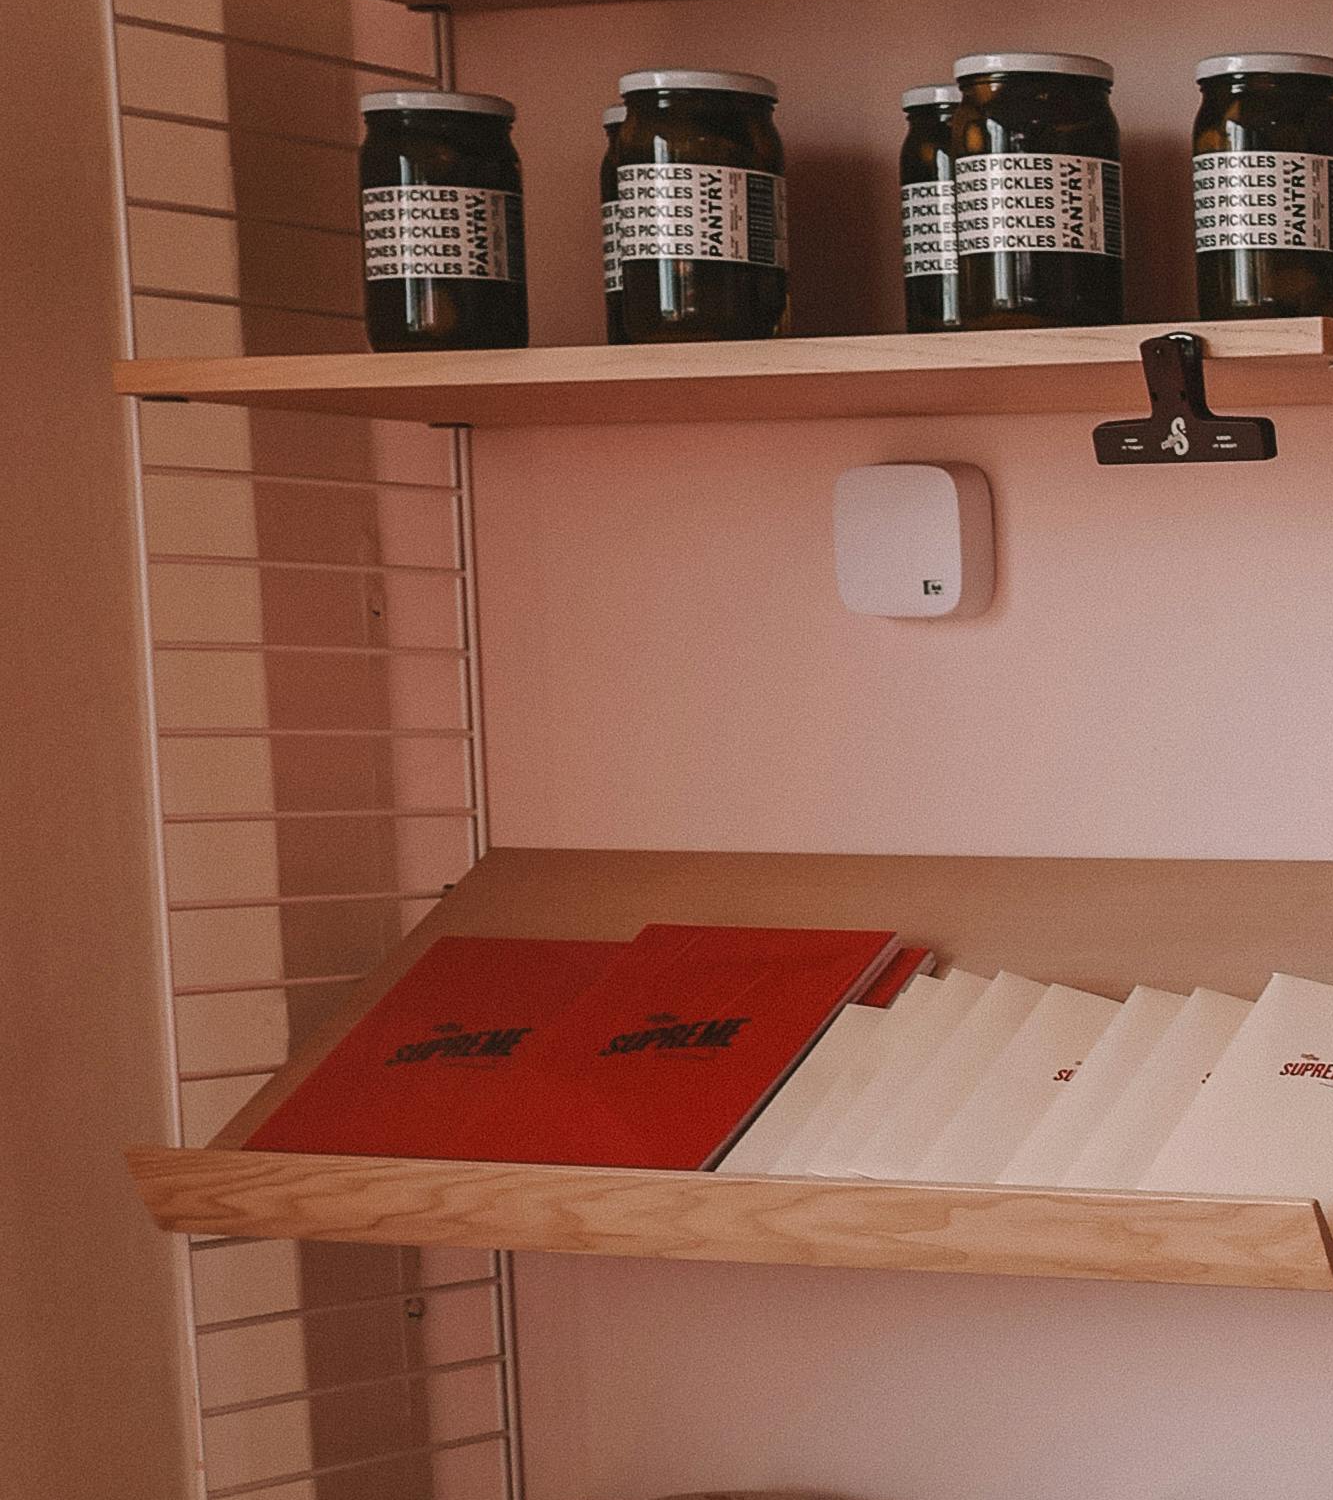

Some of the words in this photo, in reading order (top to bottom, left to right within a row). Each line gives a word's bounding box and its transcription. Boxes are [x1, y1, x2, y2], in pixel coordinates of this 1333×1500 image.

[990, 157, 1053, 171] PICKLES
[1217, 155, 1276, 169] PICKLES
[637, 168, 693, 180] PICKLES
[1218, 174, 1277, 188] PICKLES
[990, 177, 1054, 191] PICKLES
[397, 190, 458, 202] PICKLES
[637, 186, 693, 199] PICKLES
[991, 196, 1055, 210] PICKLES
[1067, 158, 1084, 249] PANTRY.
[1218, 194, 1277, 207] PICKLES
[1291, 156, 1306, 246] PANTRY.
[398, 208, 460, 220] PICKLES
[637, 205, 694, 218] PICKLES
[708, 169, 723, 257] PANTRY.
[992, 215, 1056, 229] PICKLES
[1219, 213, 1277, 226] PICKLES
[638, 224, 694, 237] PICKLES
[993, 235, 1056, 249] PICKLES
[1219, 232, 1278, 246] PICKLES
[638, 243, 694, 255] PICKLES
